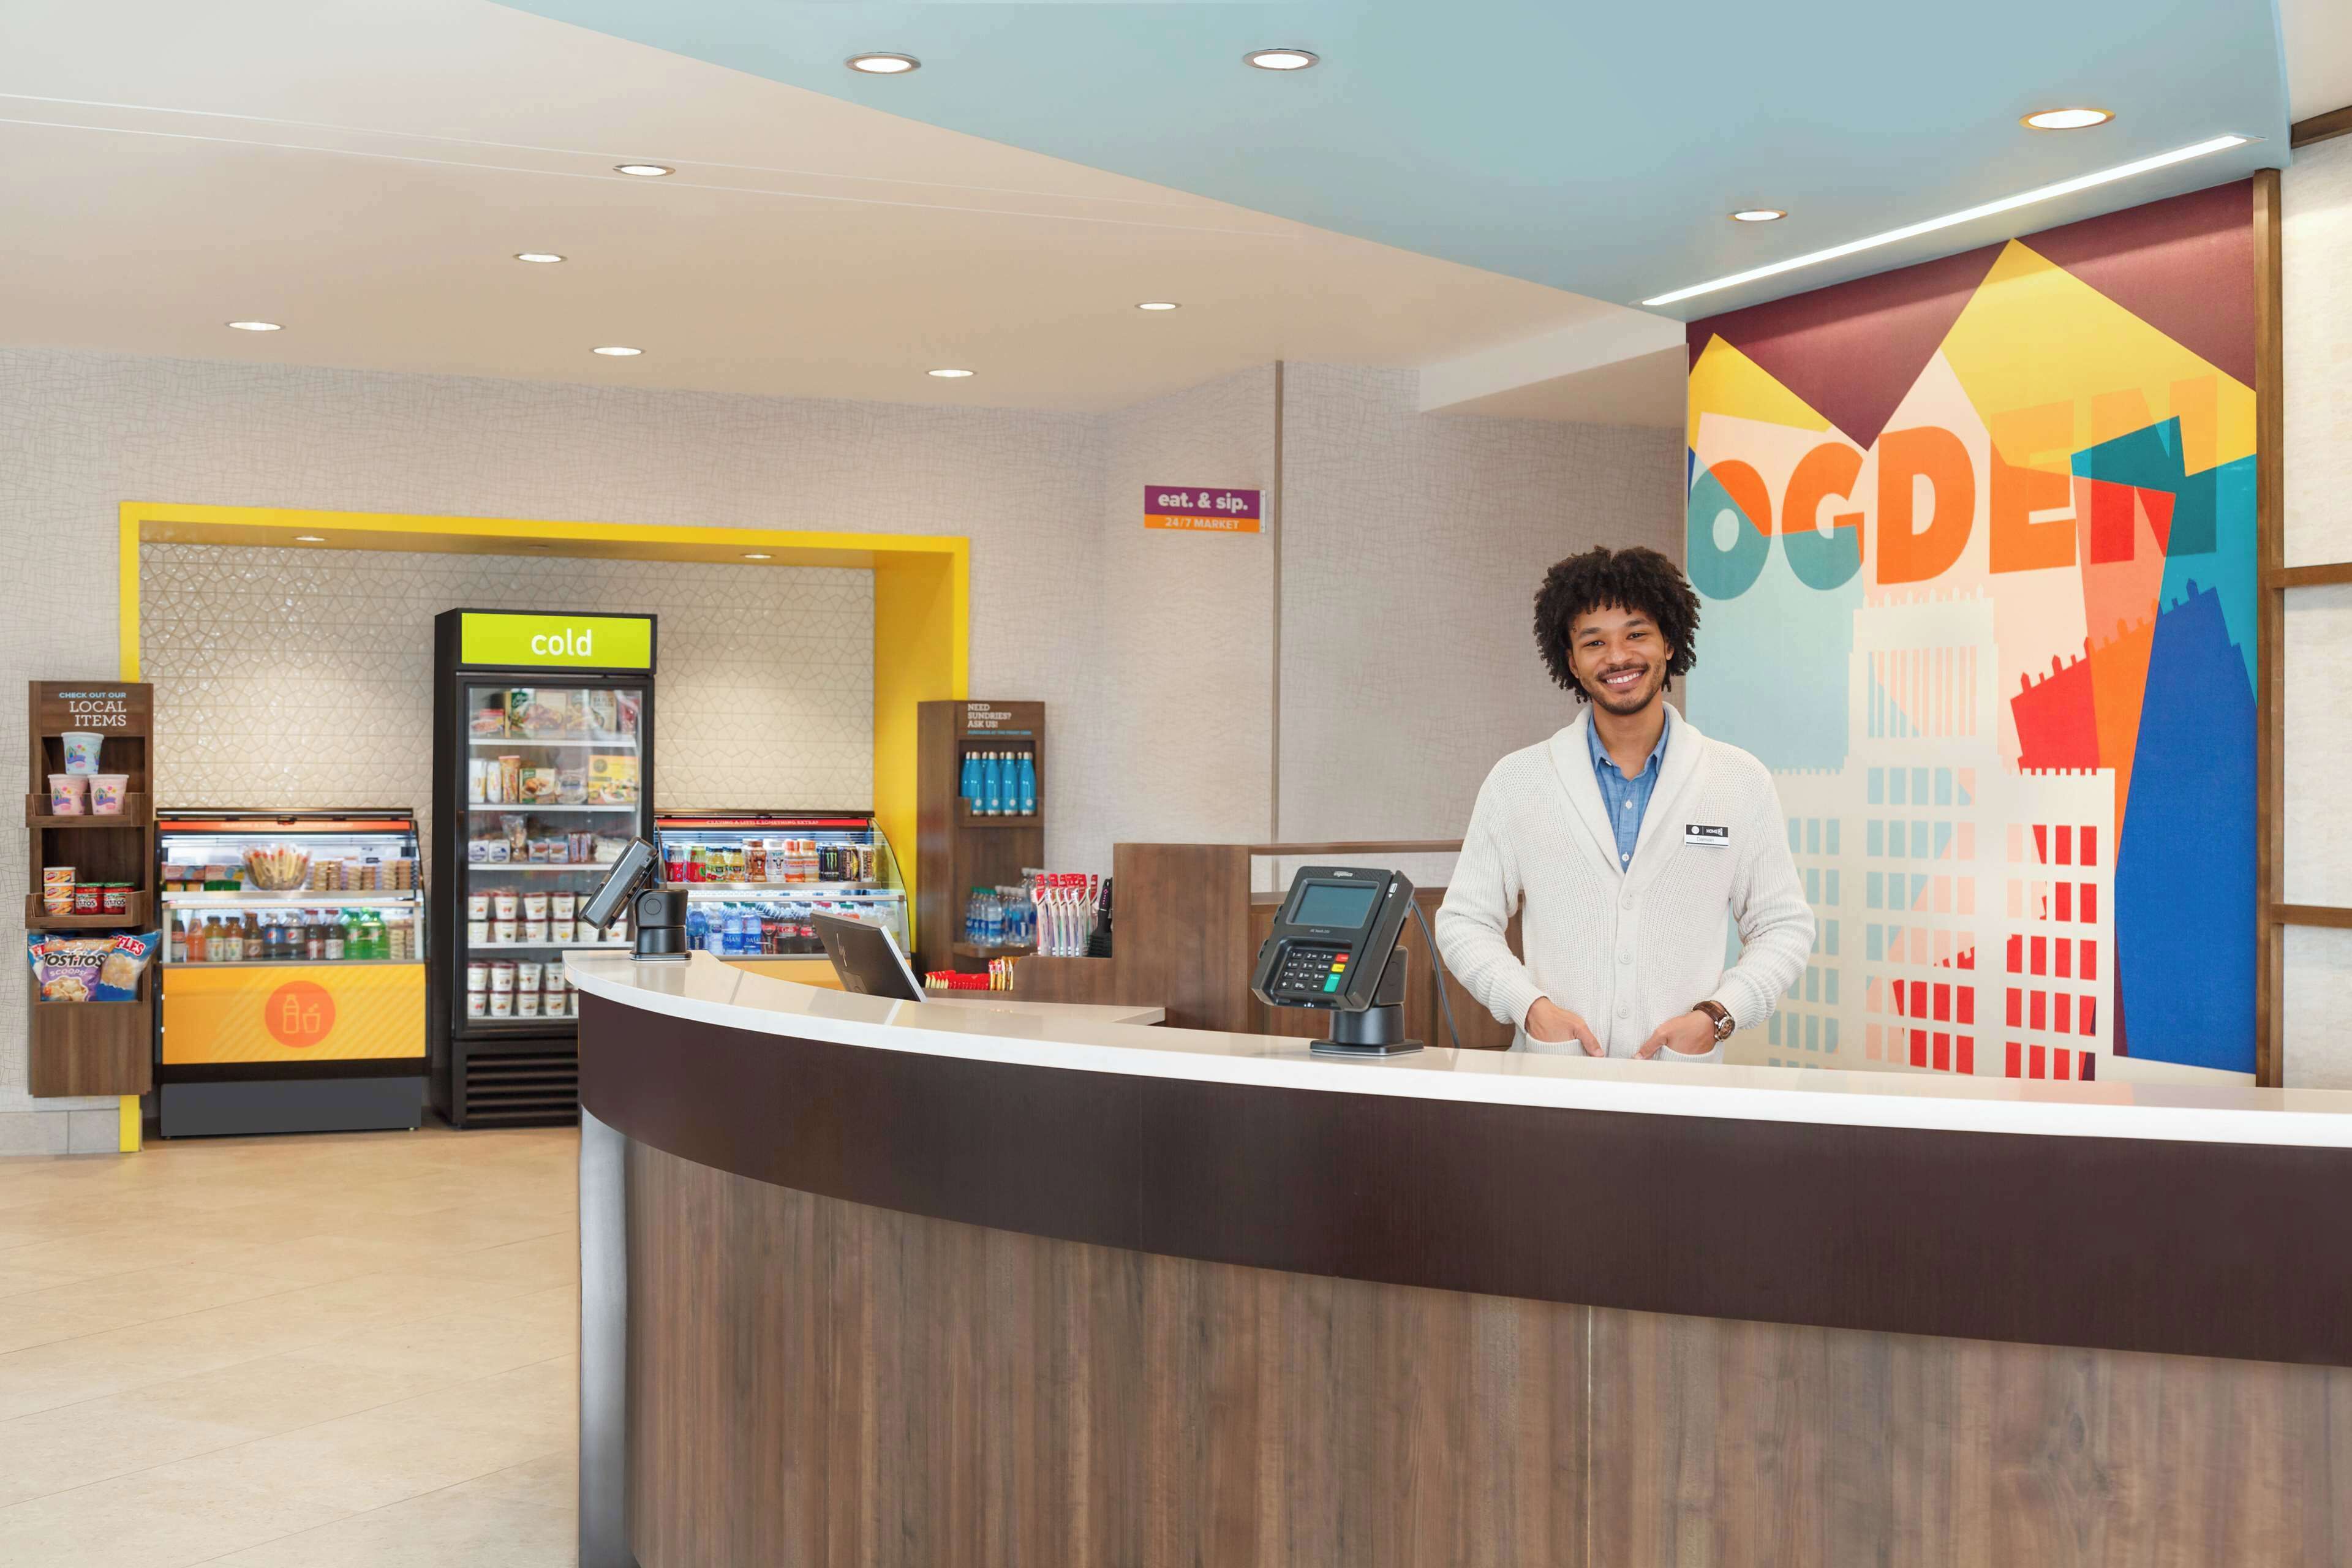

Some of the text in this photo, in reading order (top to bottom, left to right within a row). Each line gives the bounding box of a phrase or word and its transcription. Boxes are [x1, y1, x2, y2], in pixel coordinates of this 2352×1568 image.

[1688, 374, 2217, 600] OGDEN
[1158, 492, 1248, 513] eat. & sip.
[1166, 518, 1239, 530] 24/7 MARKET
[531, 628, 592, 657] cold
[69, 701, 127, 712] LOCAL
[75, 715, 126, 726] ITEMS
